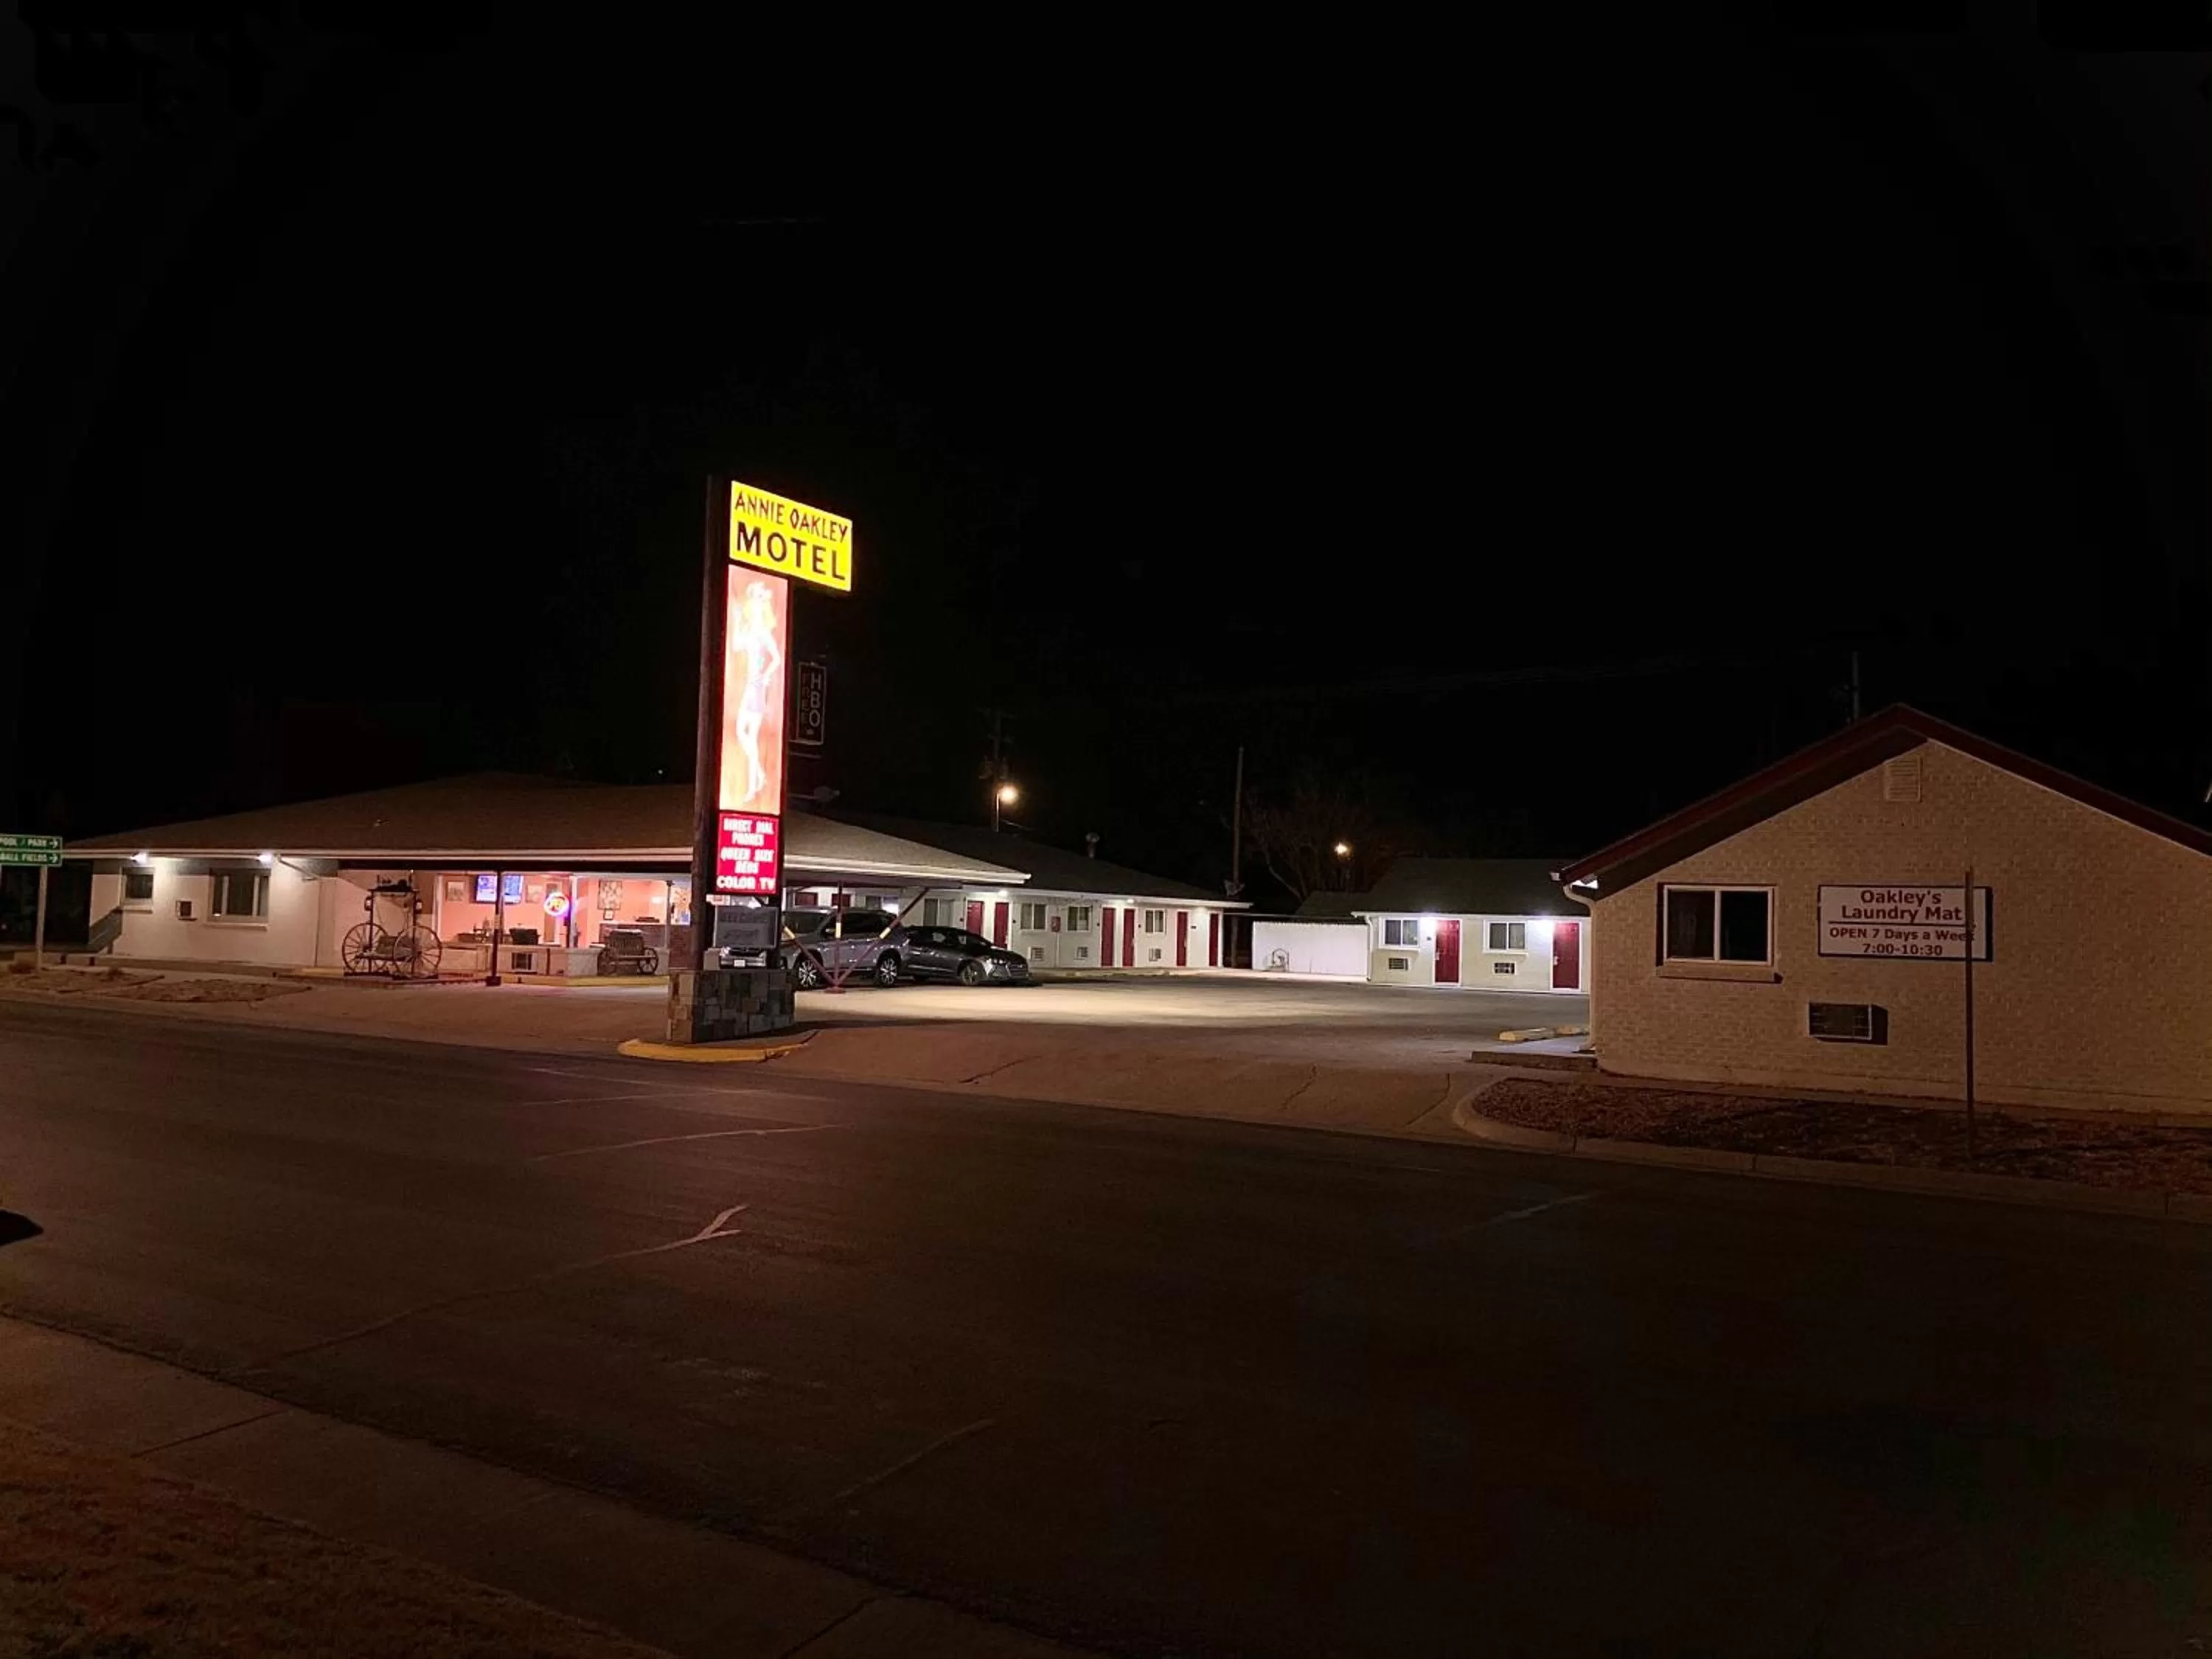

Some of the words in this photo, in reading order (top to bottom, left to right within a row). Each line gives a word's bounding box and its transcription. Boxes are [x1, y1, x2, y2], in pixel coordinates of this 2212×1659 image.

[735, 490, 785, 525] ANNIE
[790, 508, 848, 543] OAKLEY
[737, 521, 846, 581] MOTEL
[809, 672, 821, 727] HBO
[717, 875, 757, 890] COLOR
[759, 877, 776, 891] TV
[1860, 889, 1941, 905] Oakley's
[1841, 905, 1920, 922] Laundry
[1924, 906, 1964, 921] Mat
[1829, 927, 1867, 939] OPEN
[1872, 928, 1880, 939] 7
[1885, 928, 1919, 942] Days
[1922, 931, 1931, 940] a
[1863, 943, 1943, 956] 7:00-10:30
